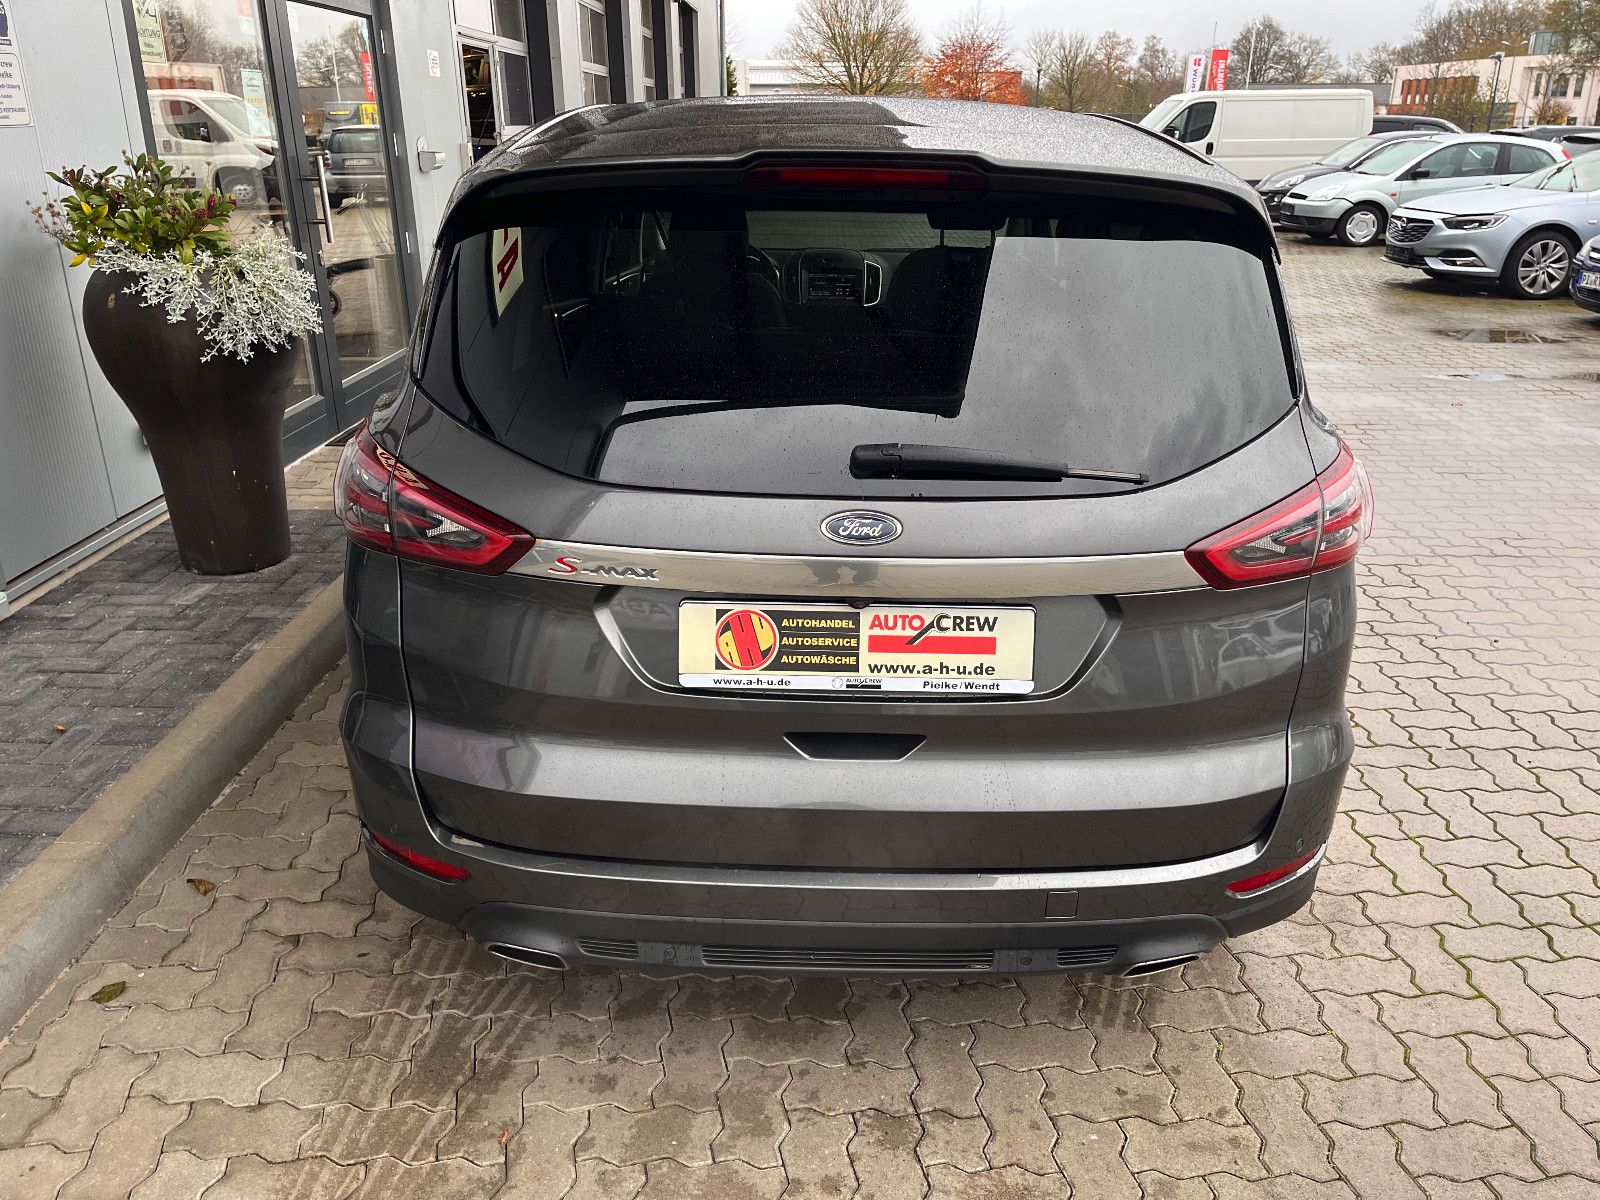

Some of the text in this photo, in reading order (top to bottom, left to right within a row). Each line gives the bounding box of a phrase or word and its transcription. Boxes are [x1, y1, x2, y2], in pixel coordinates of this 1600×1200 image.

[839, 518, 882, 537] Ford
[548, 556, 660, 581] S-MAX
[781, 618, 856, 628] AUTOHANDEL
[869, 614, 999, 632] AUTO CREW
[780, 636, 858, 647] AUTOSERVICE
[780, 654, 857, 665] AUTOWÄSCHE
[867, 662, 996, 676] www.a-h-u.de
[712, 677, 791, 687] www.a-h-u.de
